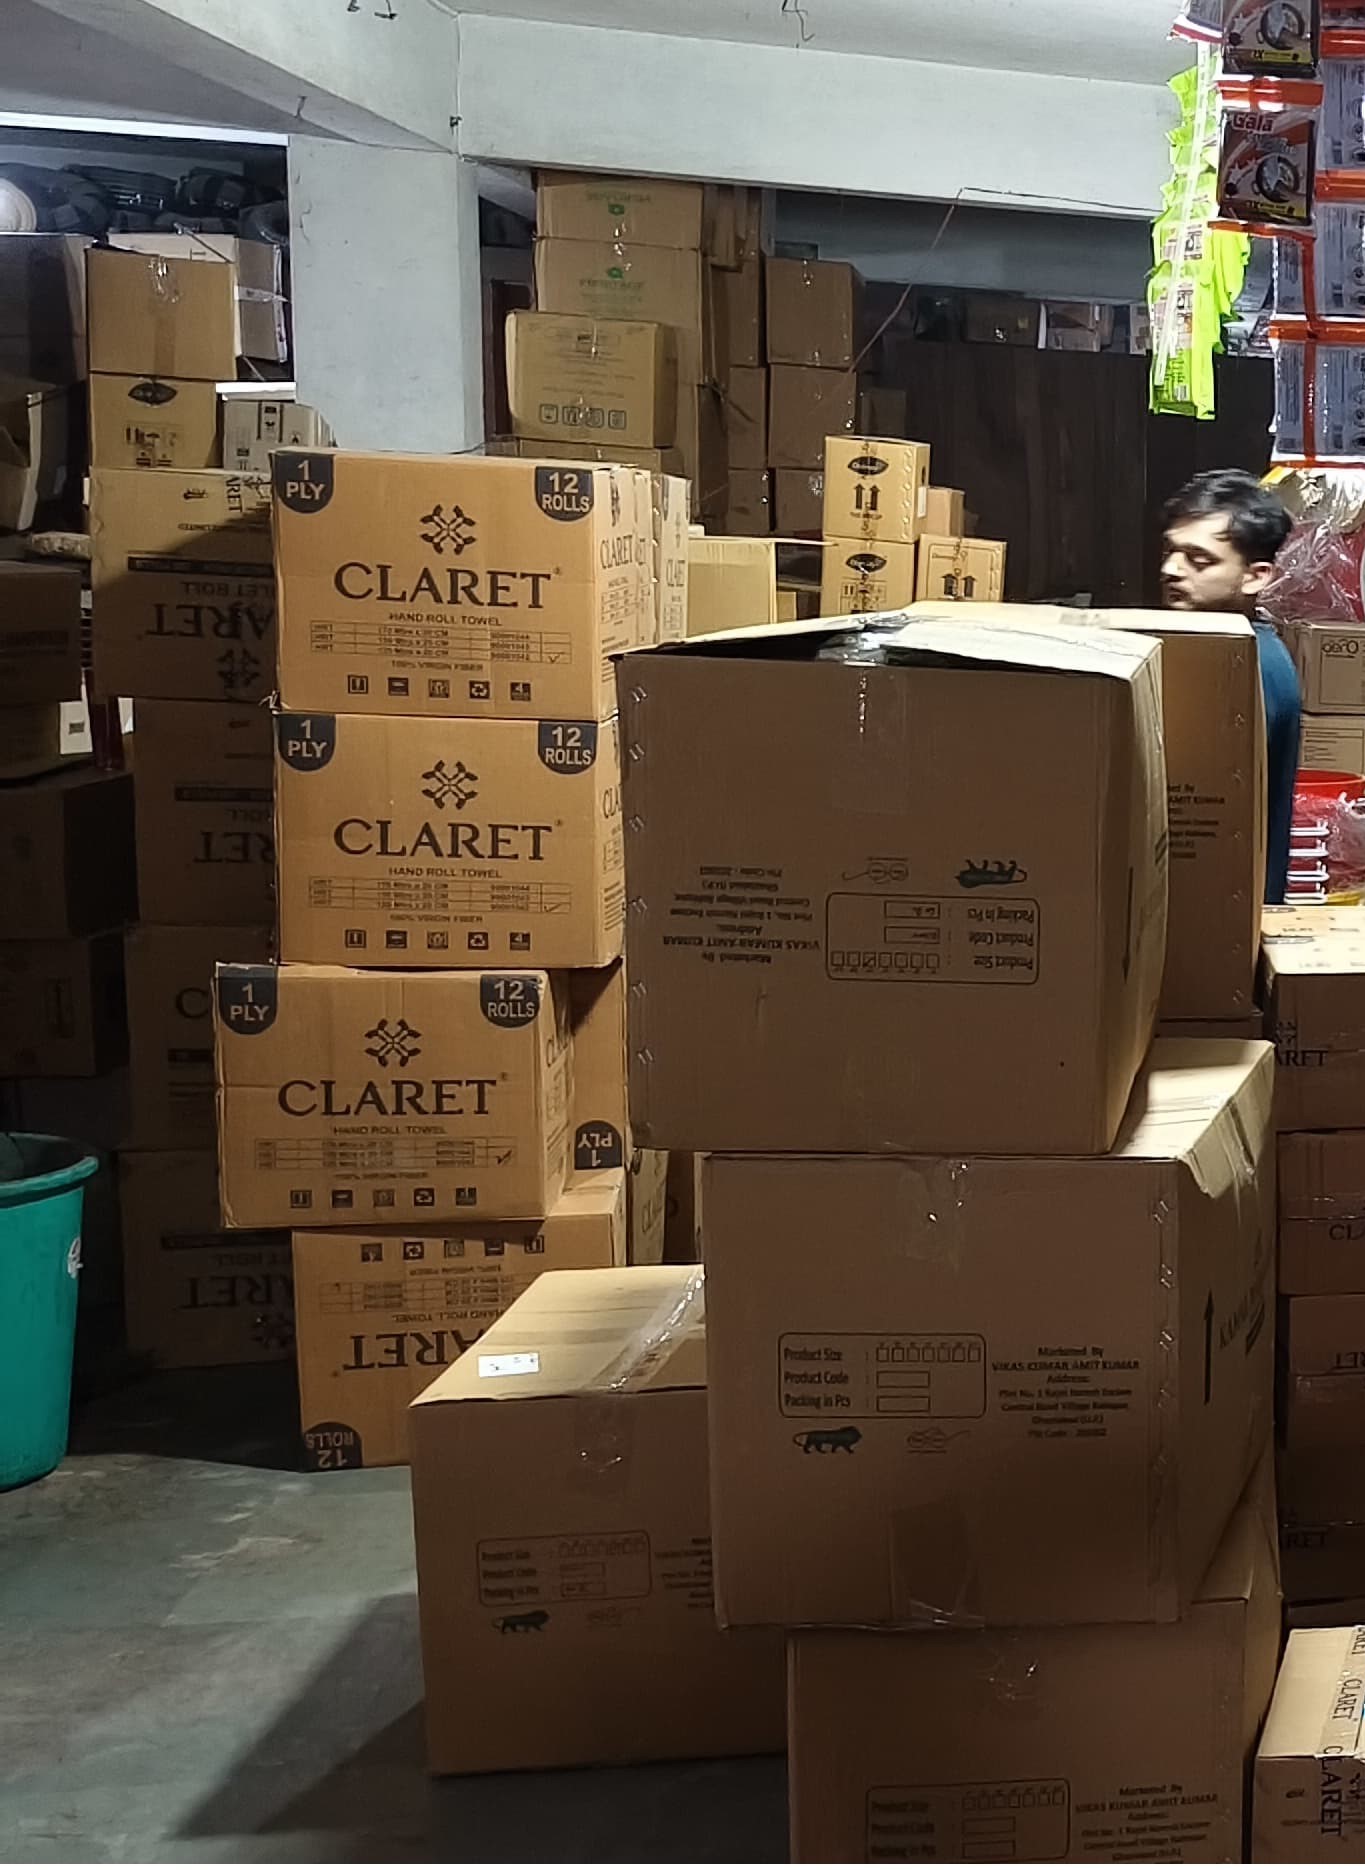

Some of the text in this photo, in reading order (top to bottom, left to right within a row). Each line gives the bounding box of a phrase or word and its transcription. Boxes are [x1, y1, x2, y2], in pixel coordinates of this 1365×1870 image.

[1232, 113, 1275, 133] Gala
[298, 460, 311, 480] 1
[286, 481, 326, 500] PLY
[549, 472, 580, 494] 12
[541, 493, 592, 513] ROLLS
[600, 535, 633, 569] CLARET
[334, 562, 552, 609] CLARET
[389, 611, 502, 627] HAND ROLL TOWEL
[301, 720, 313, 739] 1
[551, 726, 581, 747] 12
[287, 740, 327, 759] PLY
[545, 746, 592, 766] ROLLS
[334, 818, 553, 861] CLARET
[389, 866, 503, 879] HAND ROLL TOWEL
[997, 907, 1034, 923] Packing
[663, 936, 820, 952] VIKAS KUMAR AMIT KUMAR
[969, 932, 1034, 947] Product Code
[996, 956, 1033, 970] Product
[242, 983, 254, 1002] 1
[494, 980, 525, 1000] 12
[230, 1004, 270, 1022] PLY
[487, 1001, 535, 1018] ROLLS
[278, 1079, 497, 1116] CLARET
[333, 1125, 448, 1136] HAND ROLL TOWEL
[578, 1132, 613, 1149] PLY
[784, 1348, 821, 1360] Product
[992, 1361, 1139, 1371] VIKAS KUMAR AMIT KUMAR
[784, 1371, 849, 1384] Product Code
[784, 1394, 821, 1408] Packing
[305, 1432, 355, 1449] ROLLS
[316, 1449, 348, 1469] 12
[1333, 1679, 1362, 1721] CLARET
[1321, 1745, 1343, 1838] CLARET
